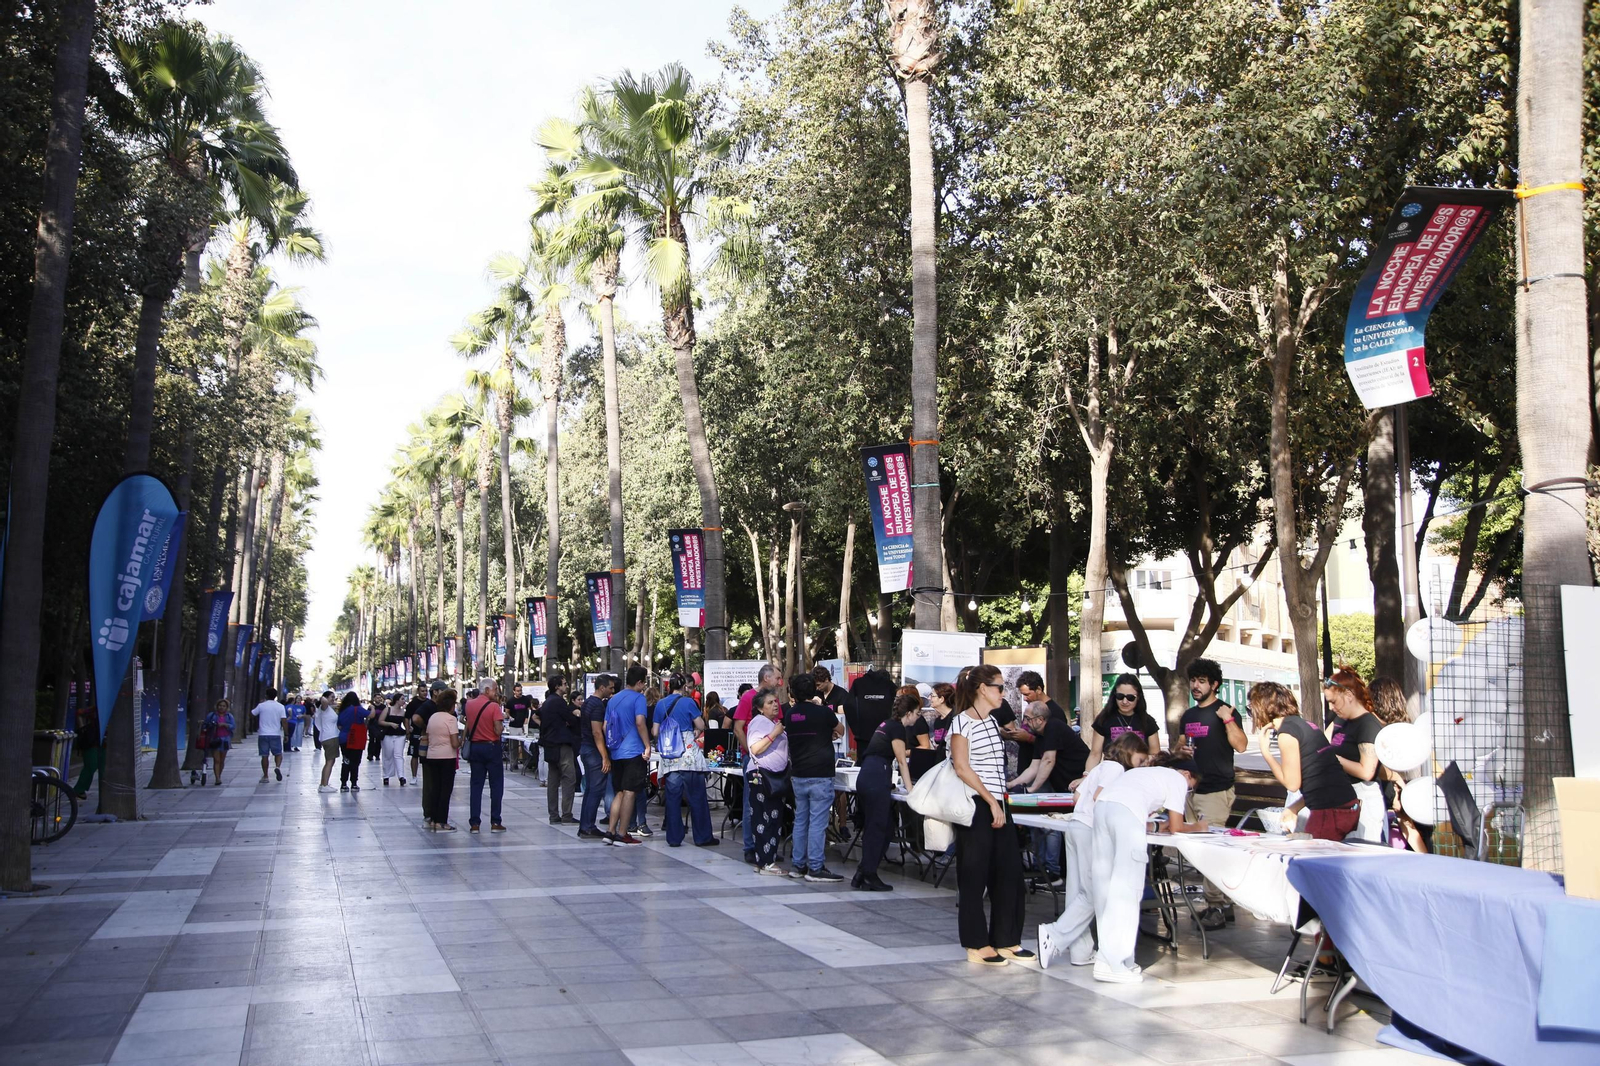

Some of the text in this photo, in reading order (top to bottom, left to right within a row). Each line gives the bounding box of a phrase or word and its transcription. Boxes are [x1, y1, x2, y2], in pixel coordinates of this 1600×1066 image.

[1369, 246, 1410, 315] LA NOCHE
[1387, 208, 1454, 312] EUROPEA DE L@S
[1405, 209, 1476, 309] INVESTIGADOR@S
[1362, 326, 1414, 341] UNIVERSIDAD
[1364, 322, 1395, 332] CIENCIA
[1369, 338, 1394, 349] CALLE
[1413, 357, 1419, 366] 2
[880, 487, 894, 535] LA NOCHE
[886, 457, 903, 534] EUROPEA DE L@S
[896, 455, 912, 533] INVESTIGADOR@S
[117, 509, 156, 611] cajamar
[143, 544, 154, 564] CAJA
[151, 518, 166, 542] RURAL
[687, 549, 693, 557] DE
[683, 580, 689, 588] LA
